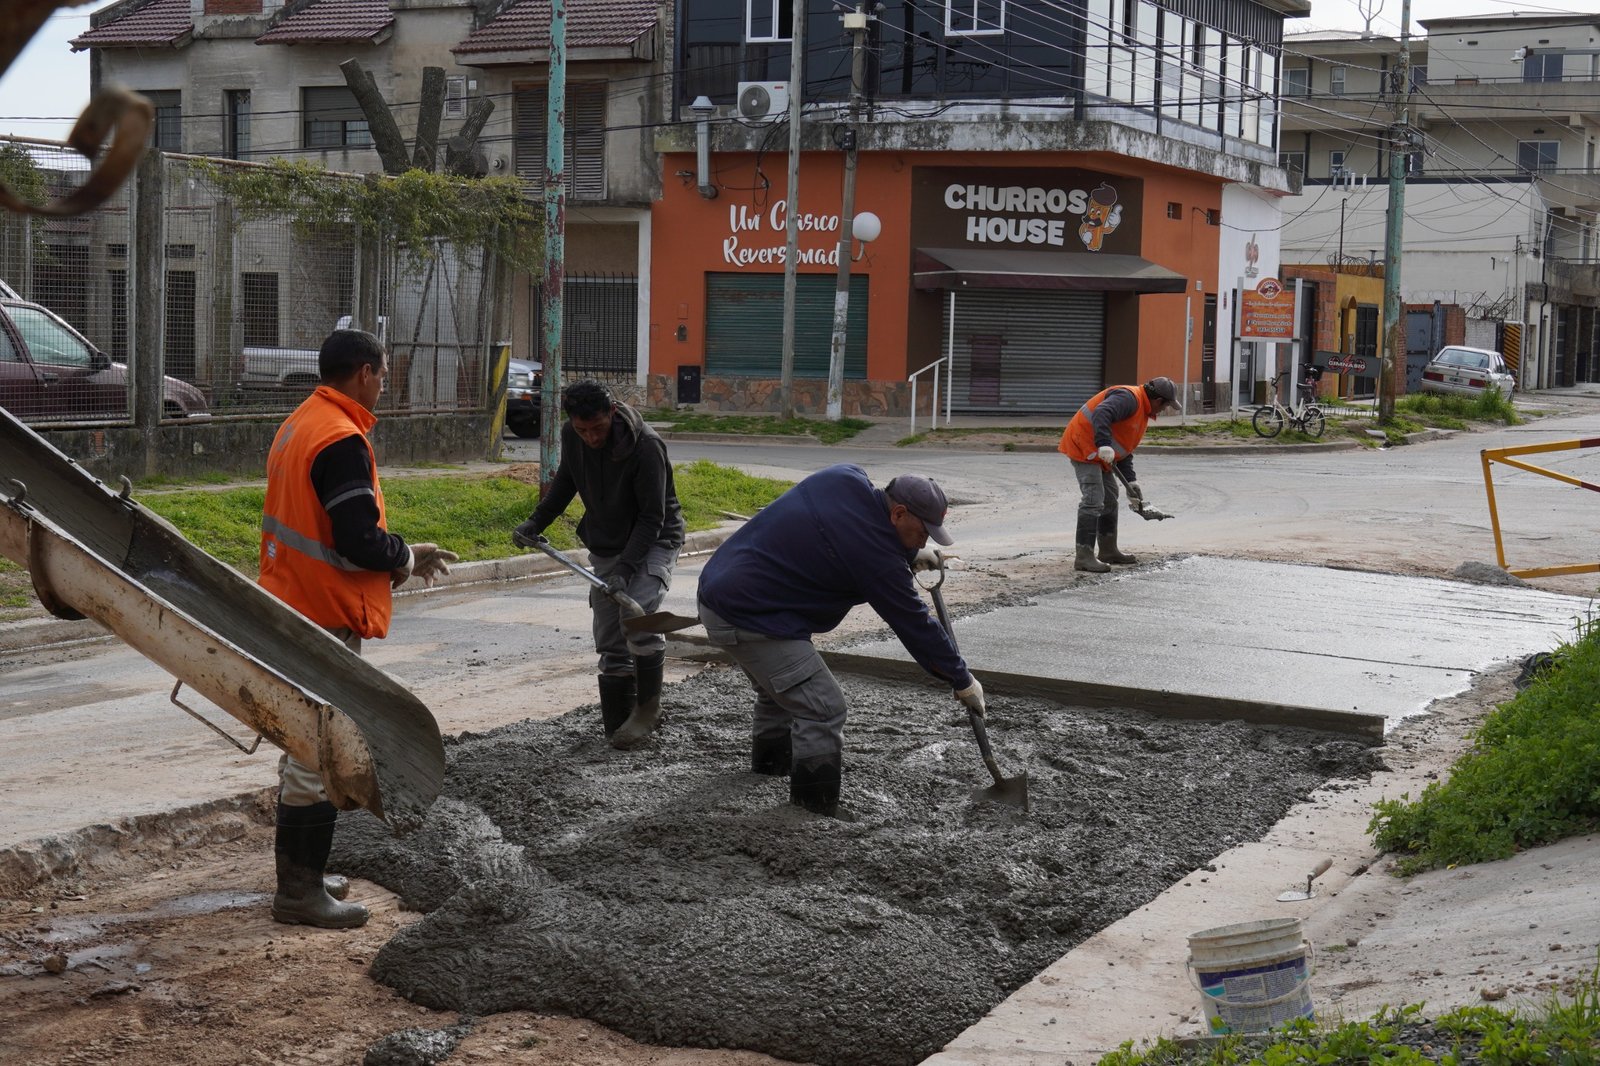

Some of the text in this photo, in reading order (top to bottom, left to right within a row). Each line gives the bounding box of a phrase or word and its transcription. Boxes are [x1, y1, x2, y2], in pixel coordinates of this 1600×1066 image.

[944, 183, 1088, 215] CHURROS
[730, 200, 839, 233] Un Casico
[966, 216, 1066, 246] HOUSE
[723, 235, 841, 267] Reversonad
